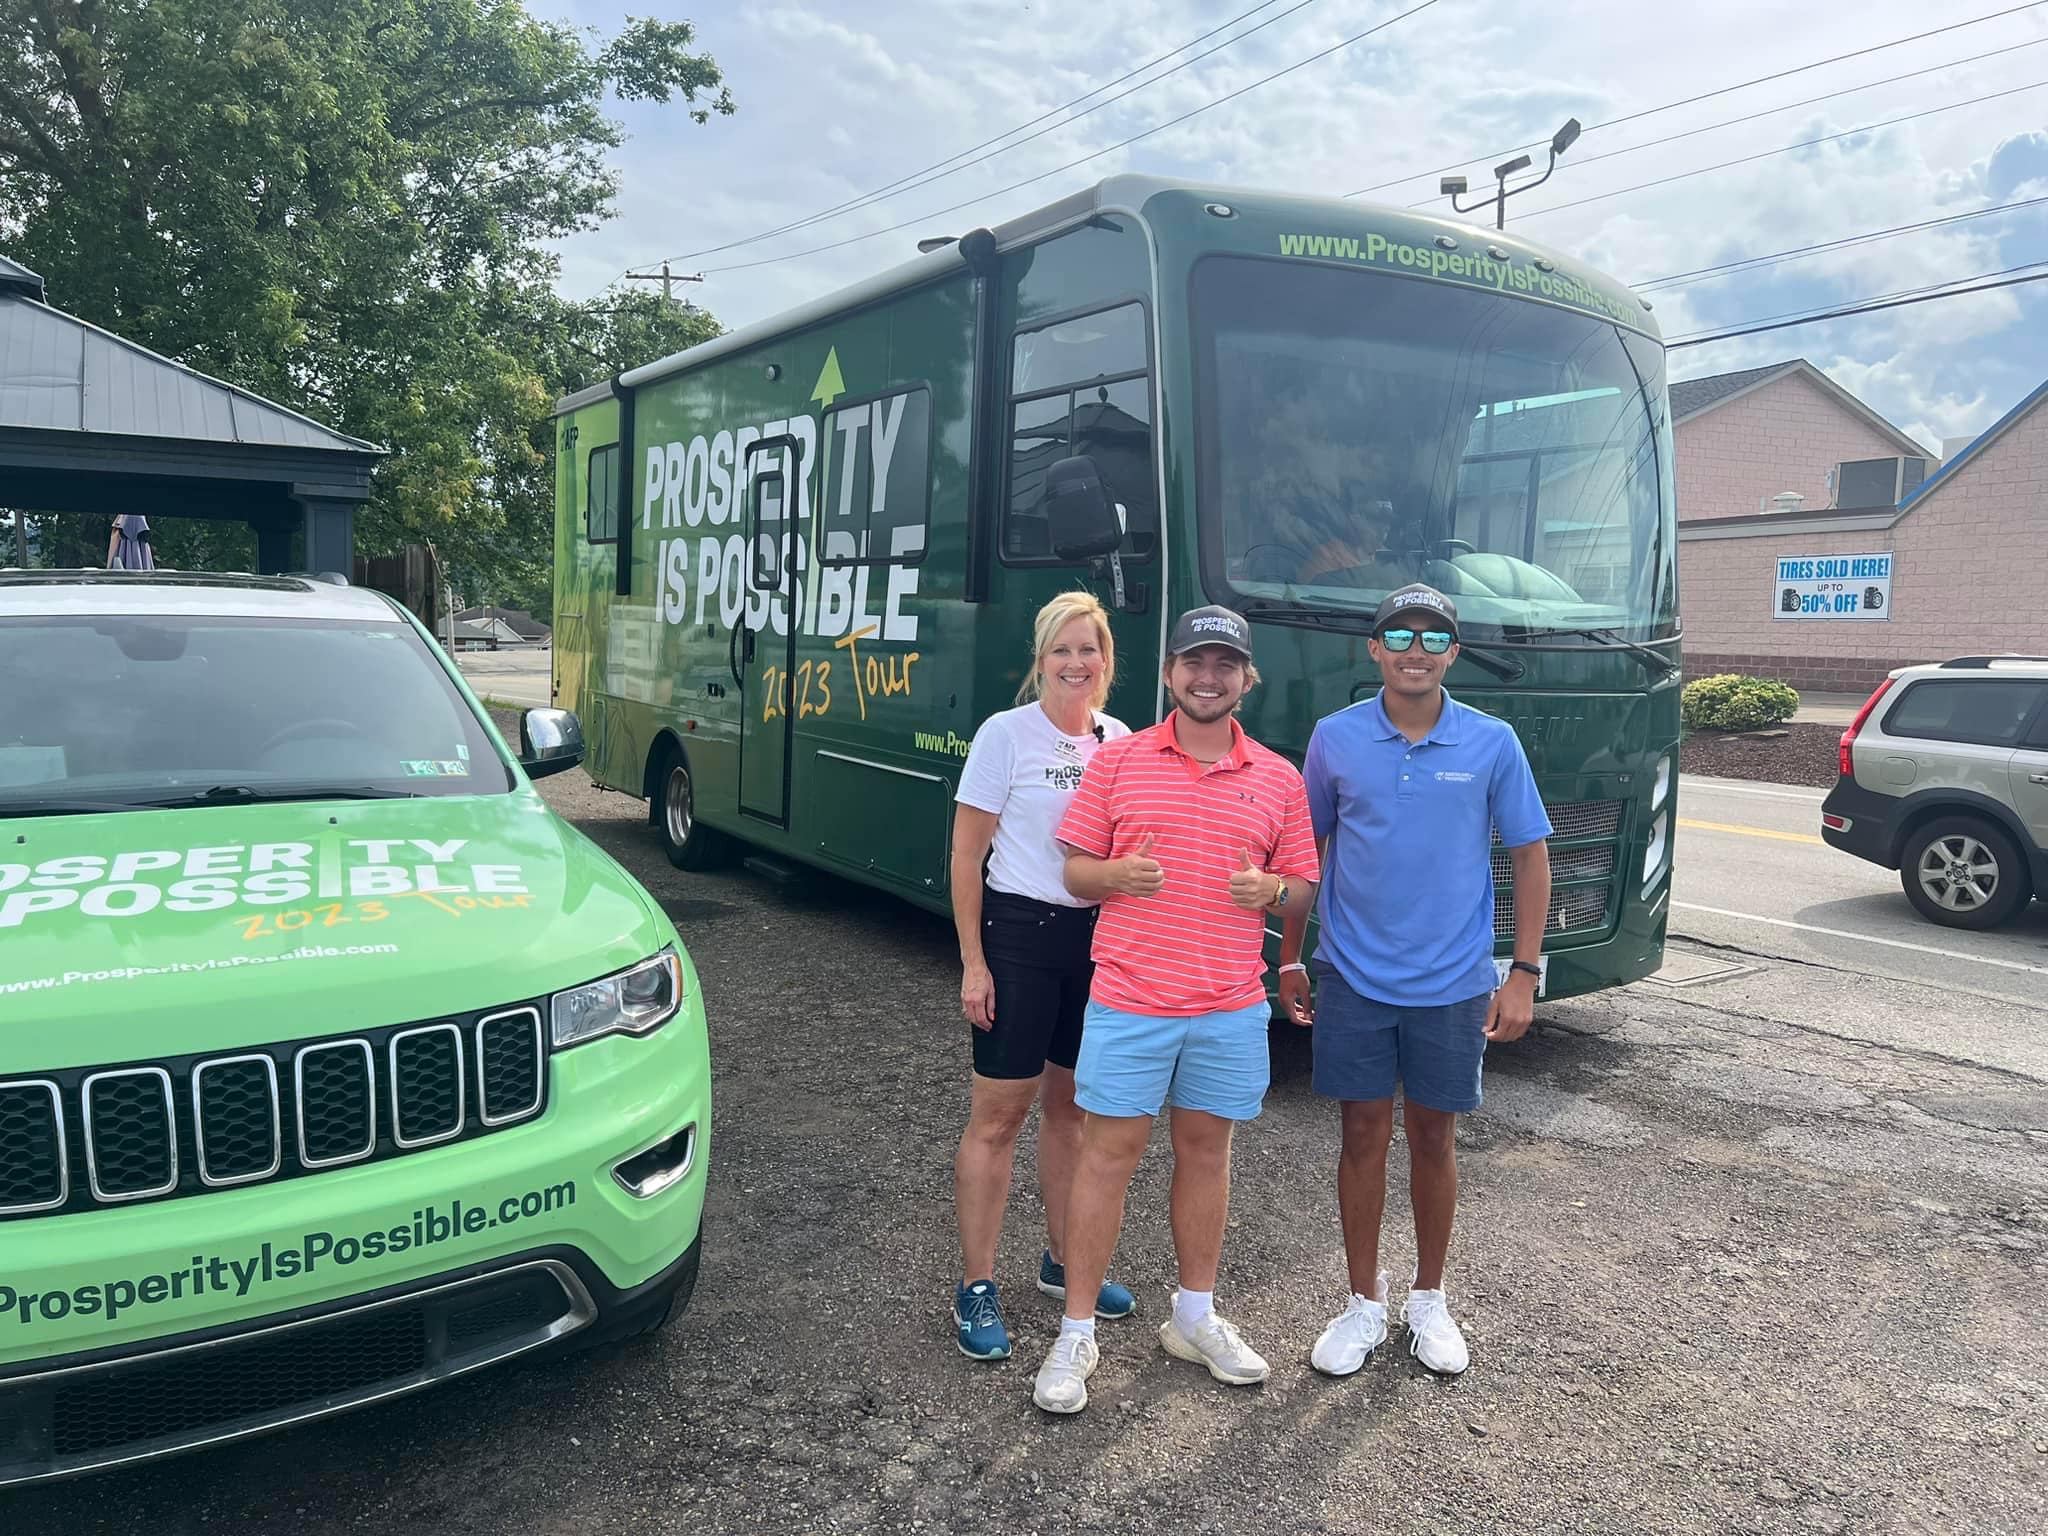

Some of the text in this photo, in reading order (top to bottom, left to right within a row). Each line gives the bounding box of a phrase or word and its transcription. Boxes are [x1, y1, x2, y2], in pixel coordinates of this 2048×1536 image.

[1279, 232, 1638, 327] www.ProsperityIsPossible.com
[643, 393, 907, 530] PROSPERITY
[655, 524, 925, 642] IS POSSIBLE
[1779, 557, 1889, 579] TIRES SOLD HERE!
[1817, 583, 1843, 592] UP TO
[1801, 594, 1858, 613] 50% OFF
[762, 623, 920, 723] 2023 Tour
[1055, 779, 1068, 790] IS
[0, 864, 528, 928] POSSIBLE
[233, 887, 536, 940] 2023 Tour
